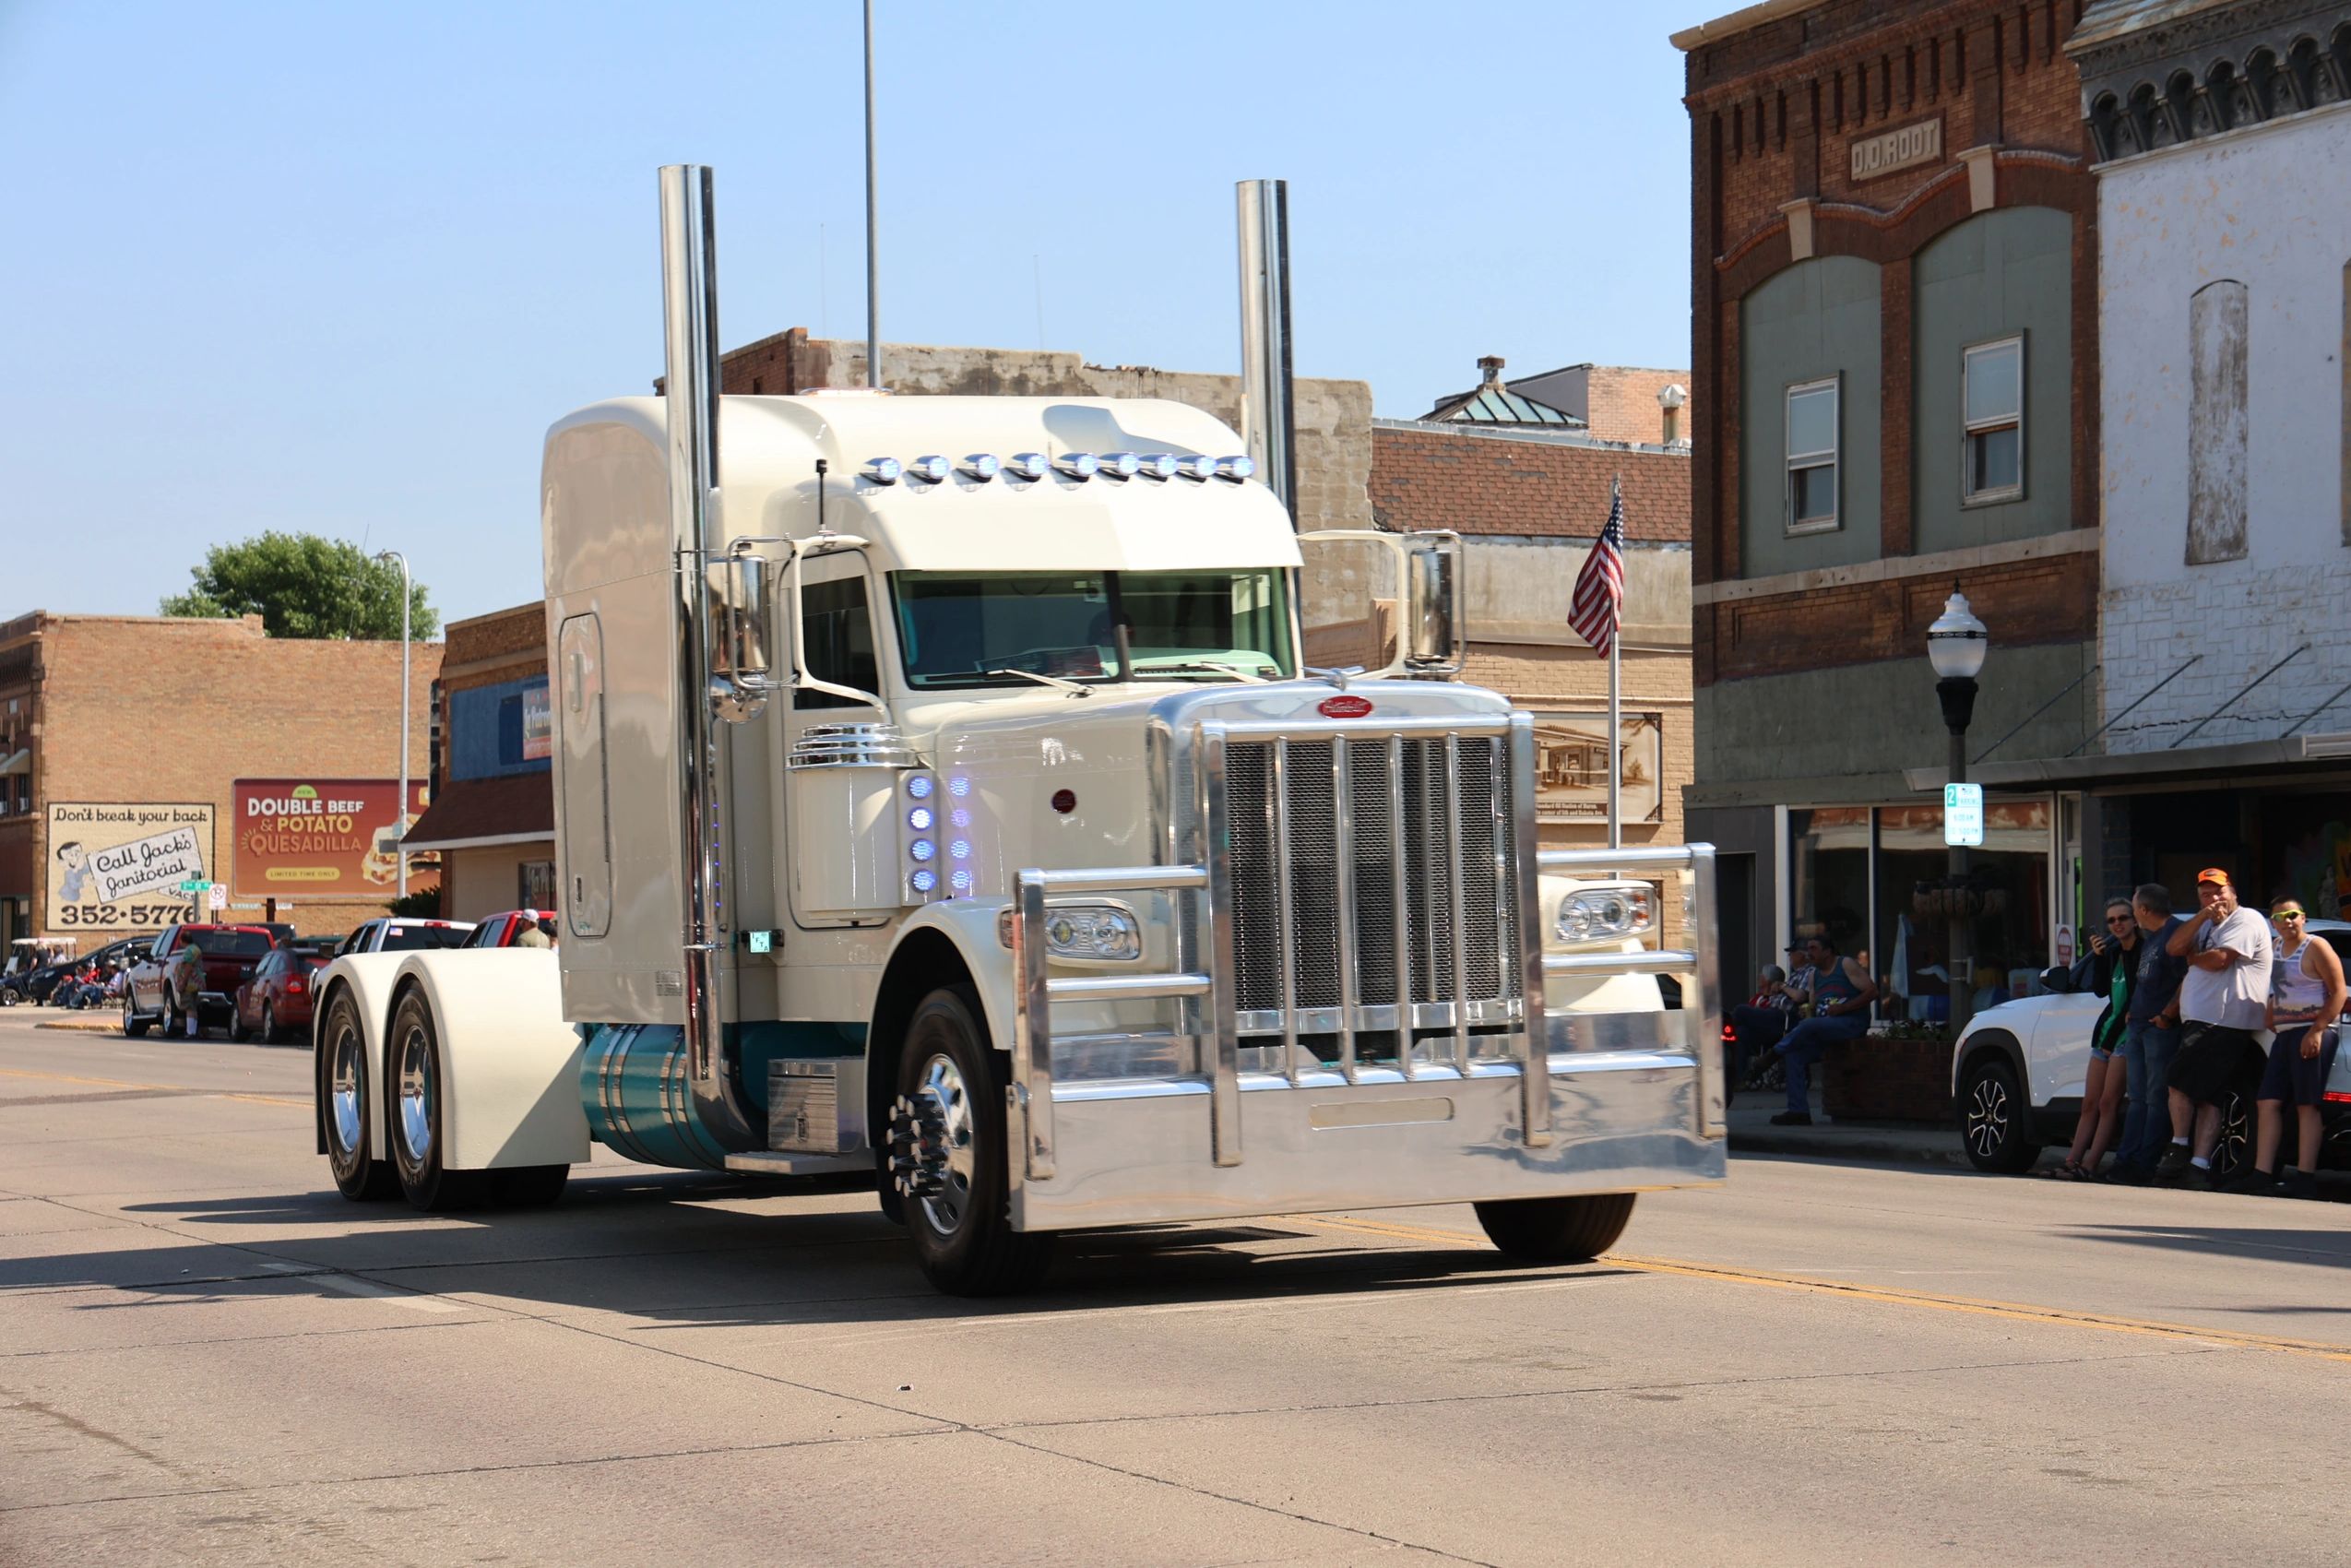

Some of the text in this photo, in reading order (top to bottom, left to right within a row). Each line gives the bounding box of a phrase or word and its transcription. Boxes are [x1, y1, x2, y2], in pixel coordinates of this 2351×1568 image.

[1948, 788, 1955, 804] 2
[54, 808, 208, 826] Don't break your back
[248, 798, 364, 816] DOUBLE BEEF
[260, 814, 352, 834] & POTATO
[97, 834, 192, 873] Call Jack's
[250, 834, 362, 857] QUESADILLA
[106, 859, 187, 898] Janitorial
